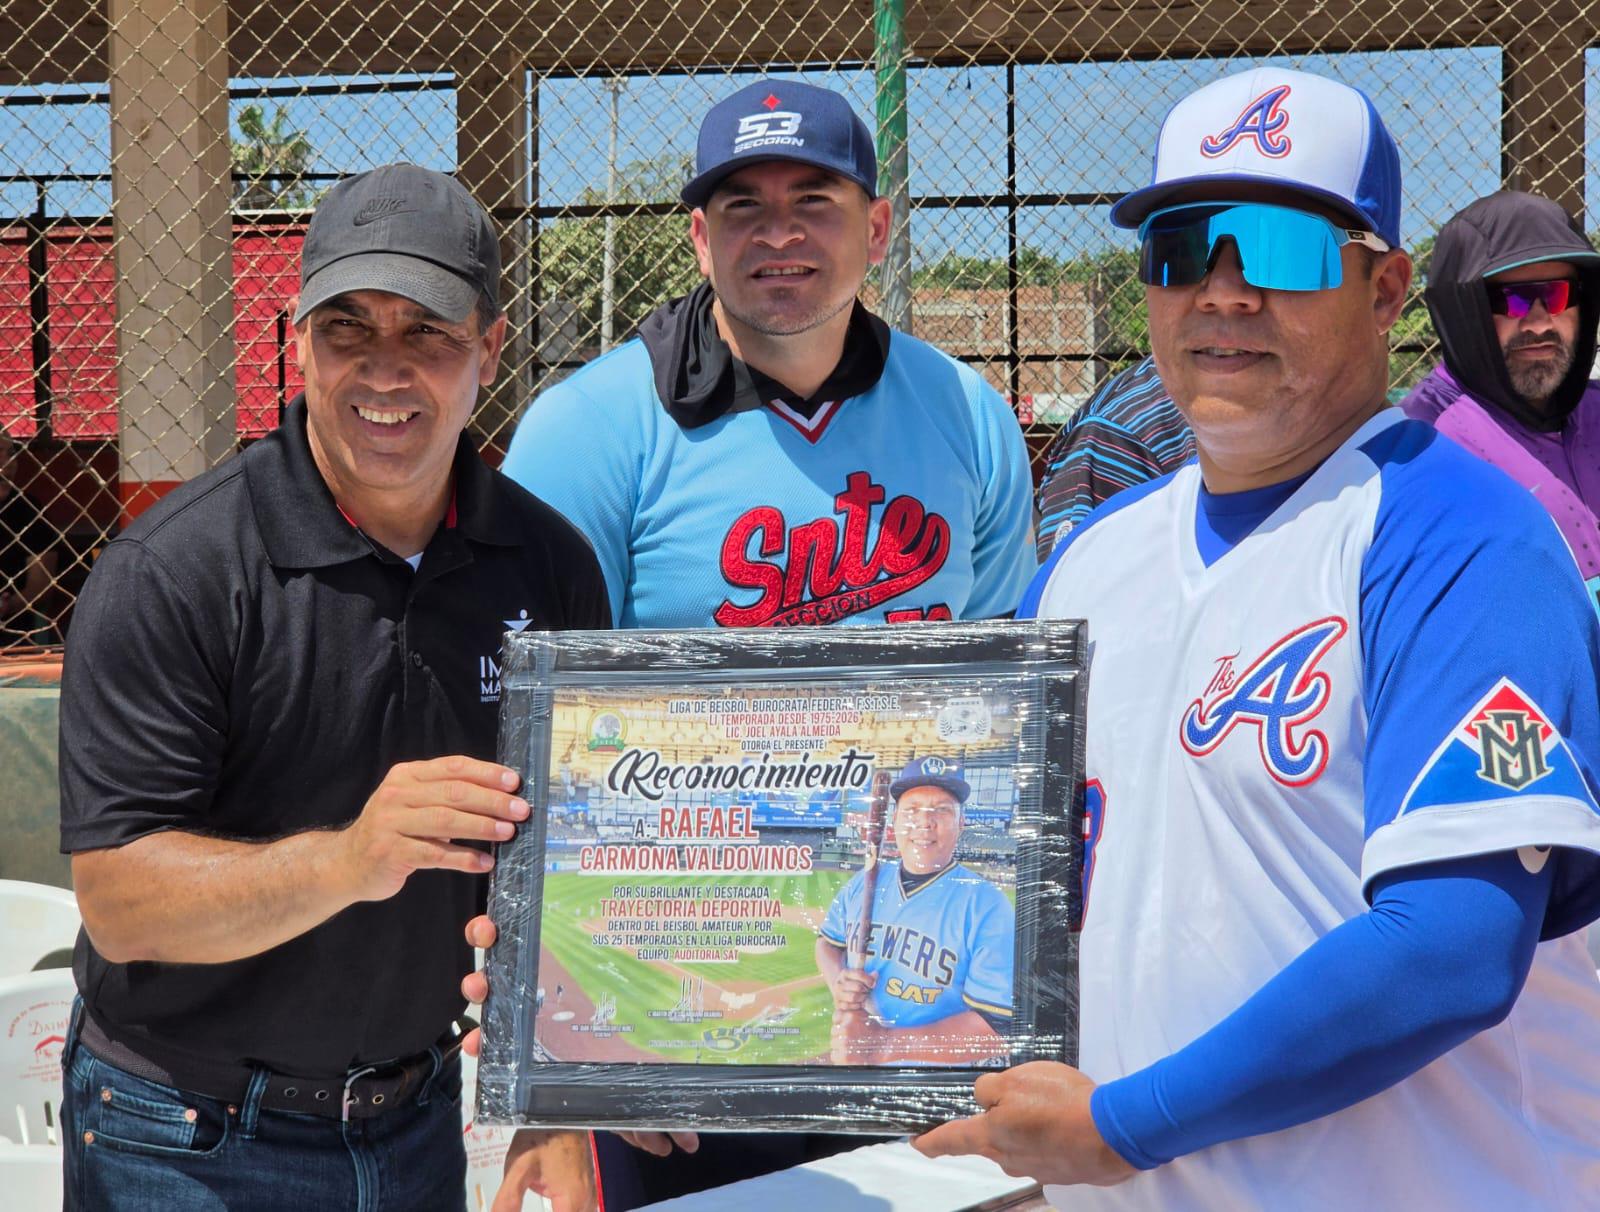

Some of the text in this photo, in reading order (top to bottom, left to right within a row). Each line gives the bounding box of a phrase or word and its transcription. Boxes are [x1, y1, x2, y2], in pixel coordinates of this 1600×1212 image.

[735, 111, 803, 145] 53
[1200, 84, 1292, 159] A
[733, 136, 804, 154] SECCION
[712, 471, 951, 627] Snte
[670, 701, 691, 714] LIGA
[694, 701, 706, 713] DE
[709, 700, 749, 713] BEISBOL
[752, 699, 809, 712] BUROCRATA
[812, 698, 854, 711] FEDERAL
[1179, 615, 1348, 788] The A
[721, 714, 775, 725] TEMPORADA
[778, 713, 807, 724] DESDE
[725, 725, 841, 738] LIC. JOEL AYALA ALMEIDA
[741, 740, 771, 750] OTORGA
[774, 740, 783, 750] EL
[608, 748, 875, 801] Reconocimiento
[635, 807, 759, 838] A: RAFAEL
[580, 847, 812, 871] CARMONA VALDOVINOS
[614, 886, 769, 898] POR SU BRILLANTE Y DESTACADA
[601, 900, 781, 917] TRAYECTORIA DEPORTIVA
[608, 921, 772, 931] DENTRO DEL BEISBOL AMATEUR Y POR
[592, 934, 786, 946] SUS 25 TEMPORADAS EN LA LIGA BUROCRATA
[674, 949, 720, 960] AUDITORIA
[723, 949, 738, 960] SAT
[885, 976, 943, 1004] SAT
